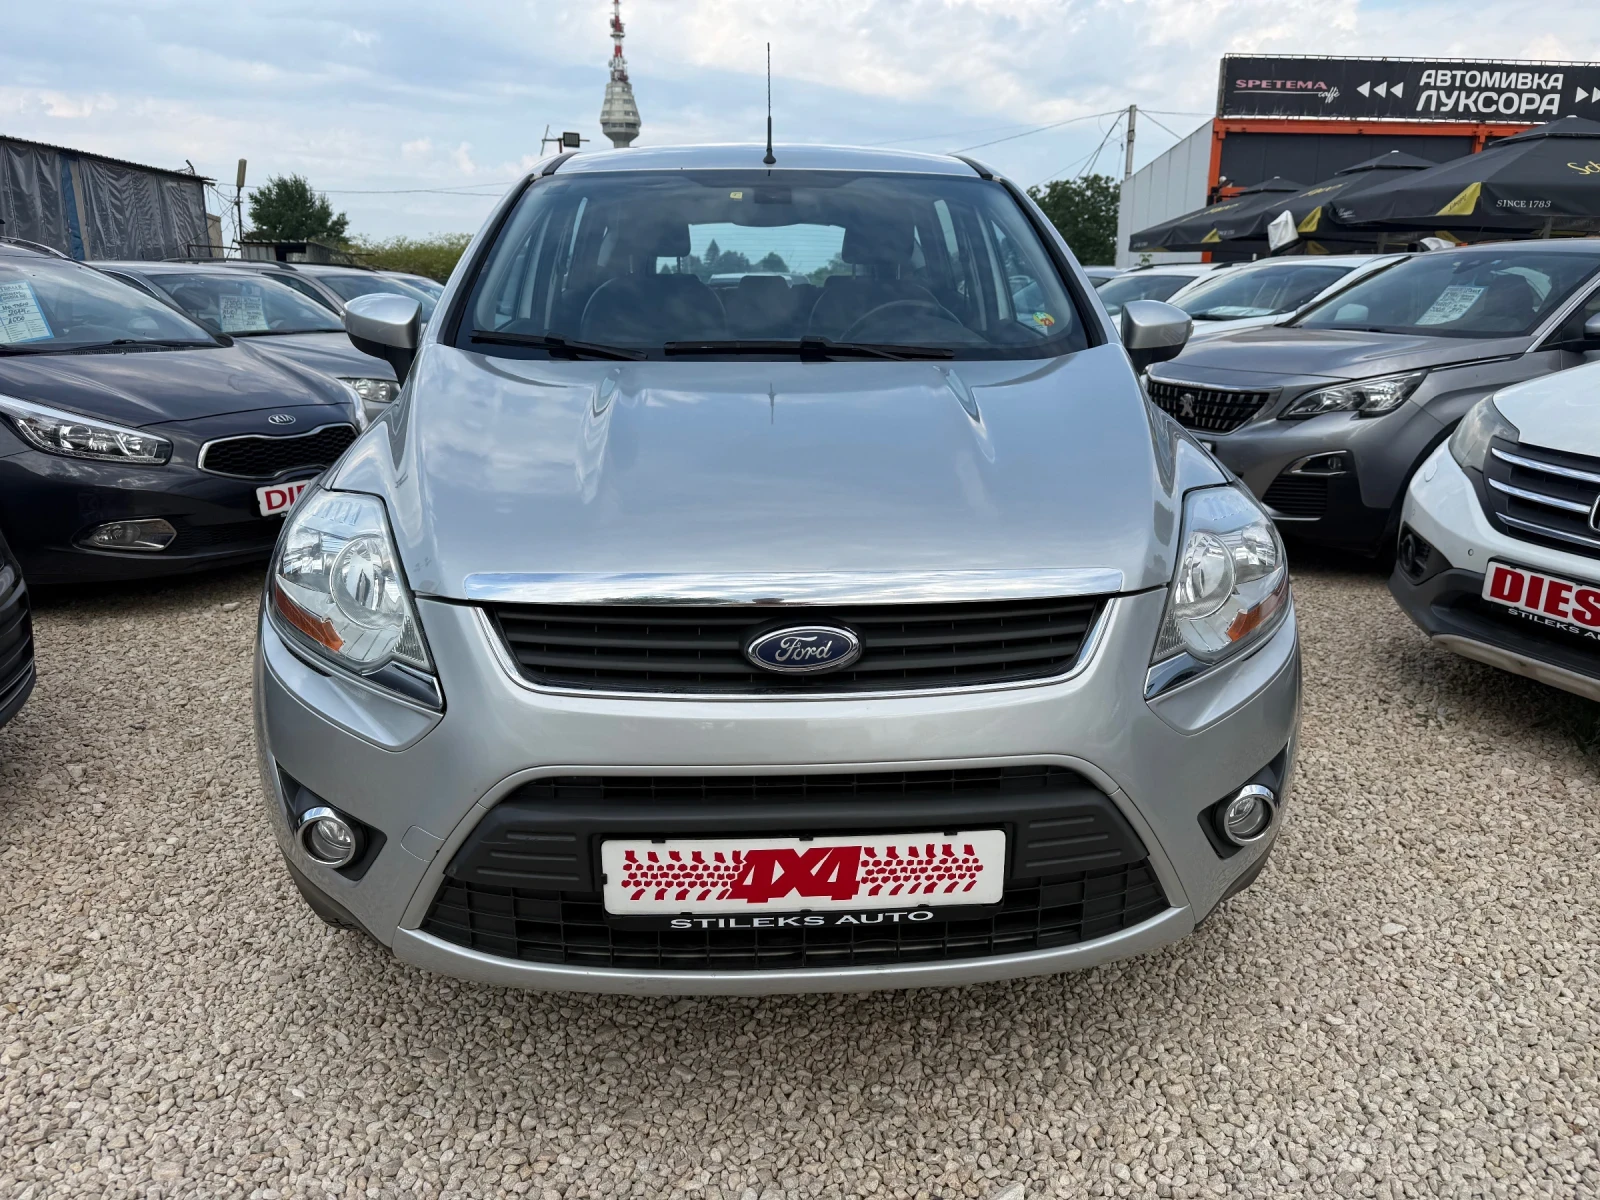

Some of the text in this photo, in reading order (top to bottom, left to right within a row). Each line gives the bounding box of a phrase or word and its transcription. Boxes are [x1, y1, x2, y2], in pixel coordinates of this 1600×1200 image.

[1235, 79, 1328, 90] SPETEMA
[1419, 69, 1564, 90] АВТОМИВКА
[1416, 90, 1561, 115] ЛУКСОРА
[1496, 199, 1552, 209] SINCE 1783
[272, 414, 293, 423] KIA
[1508, 608, 1579, 634] STILEKS
[775, 636, 833, 661] Ford
[670, 910, 934, 929] STILEKS AUTO
